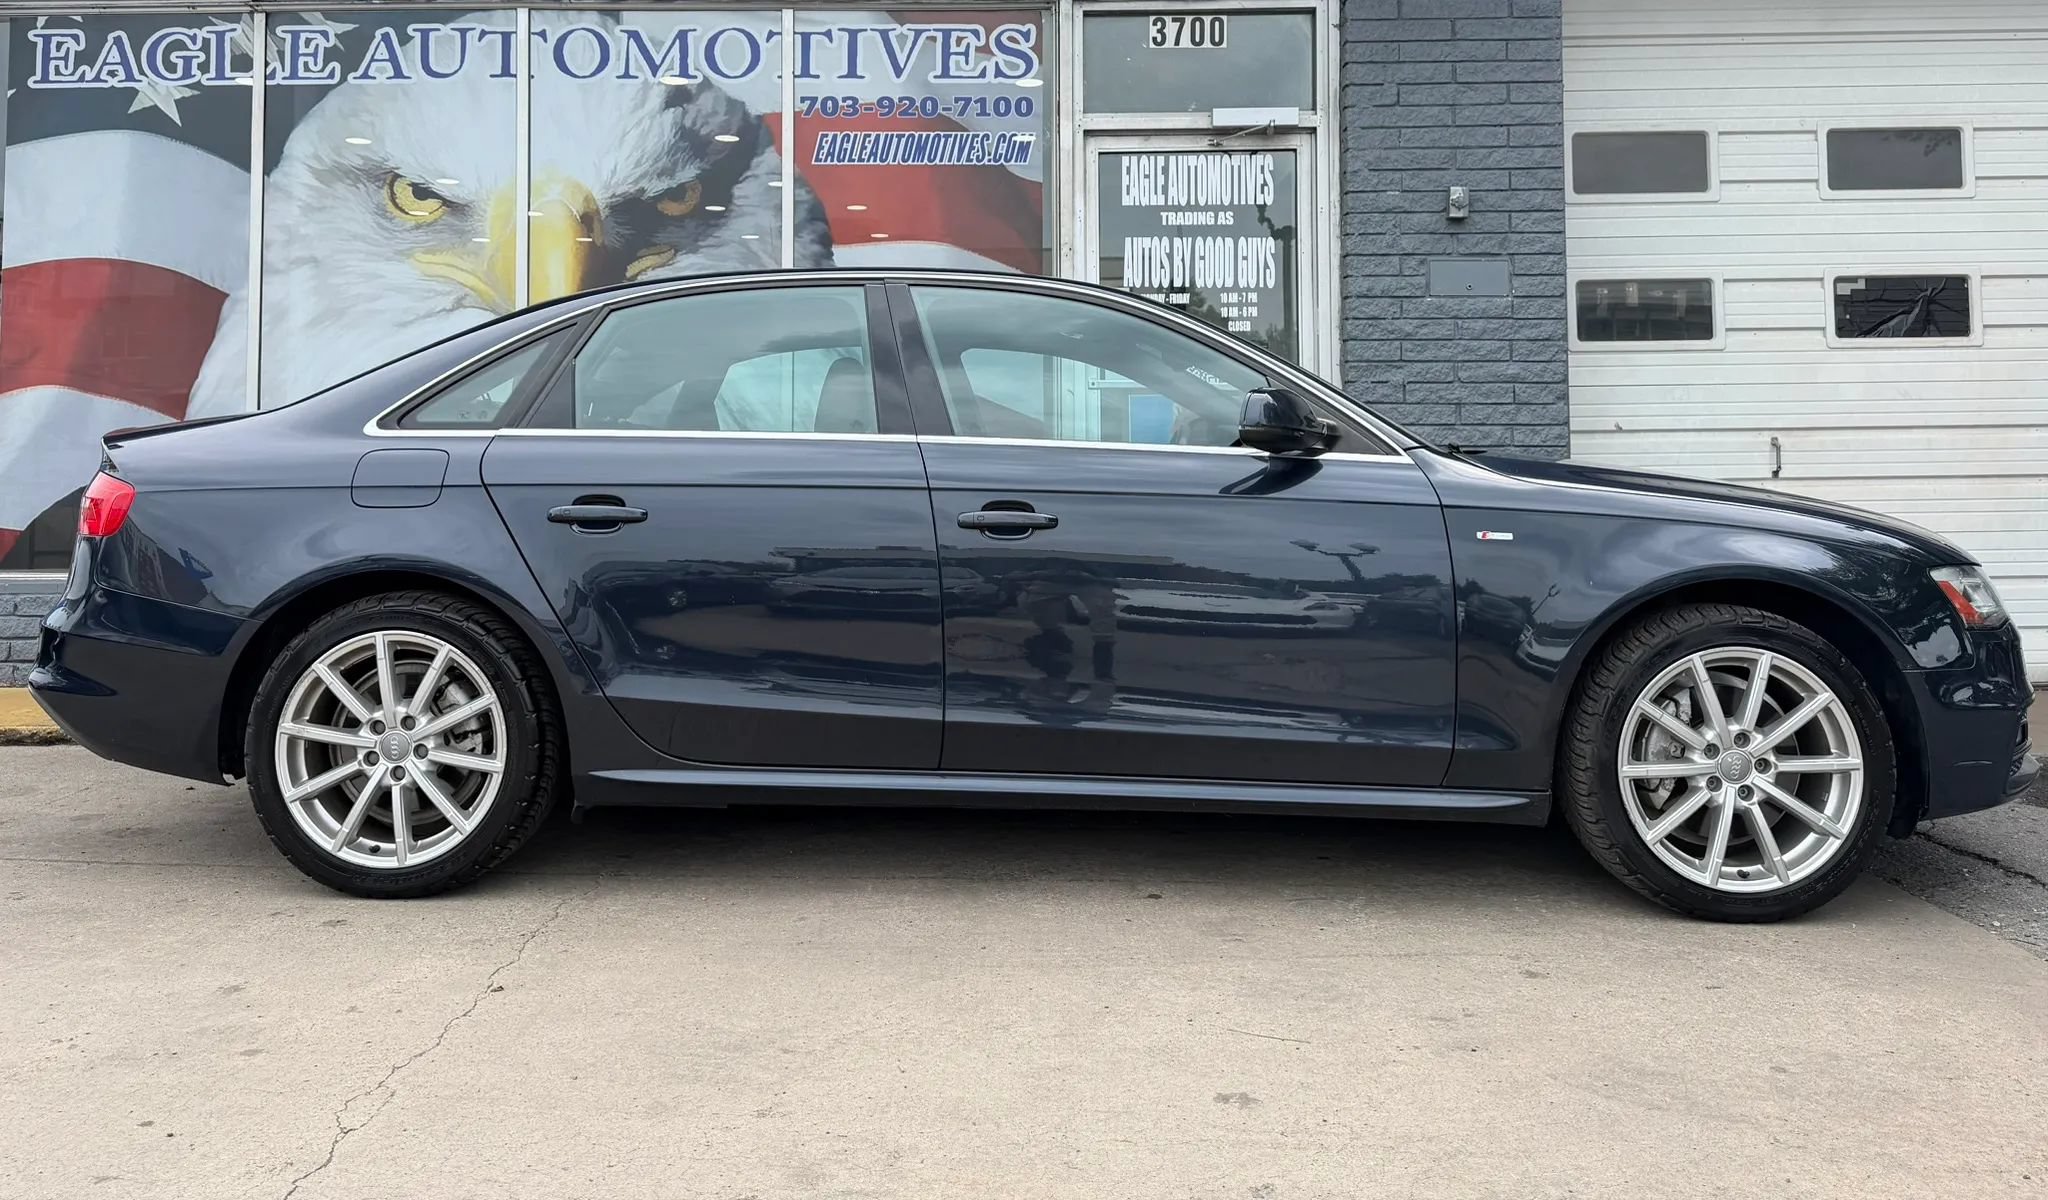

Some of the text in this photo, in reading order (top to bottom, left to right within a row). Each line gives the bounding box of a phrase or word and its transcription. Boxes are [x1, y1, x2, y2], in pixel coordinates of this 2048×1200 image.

[1152, 16, 1225, 47] 3700
[29, 24, 1039, 87] EAGLE AUTOMOTIVES
[799, 95, 1034, 118] 703-920-7100
[812, 131, 1034, 165] EAGLEAUTOMOTIVES.COM
[1121, 154, 1274, 206] EAGLE AUTOMOTIVES
[1160, 211, 1234, 226] TRADING AS
[1123, 236, 1276, 288] AUTOS BY GOOD GUYS
[1170, 293, 1190, 304] FRIDAY
[1220, 292, 1228, 303] 10
[1229, 292, 1239, 303] AM
[1248, 292, 1258, 303] PM
[1221, 307, 1228, 318] 10
[1229, 306, 1239, 317] AM
[1248, 306, 1258, 317] PM
[1228, 320, 1251, 332] CLOSED
